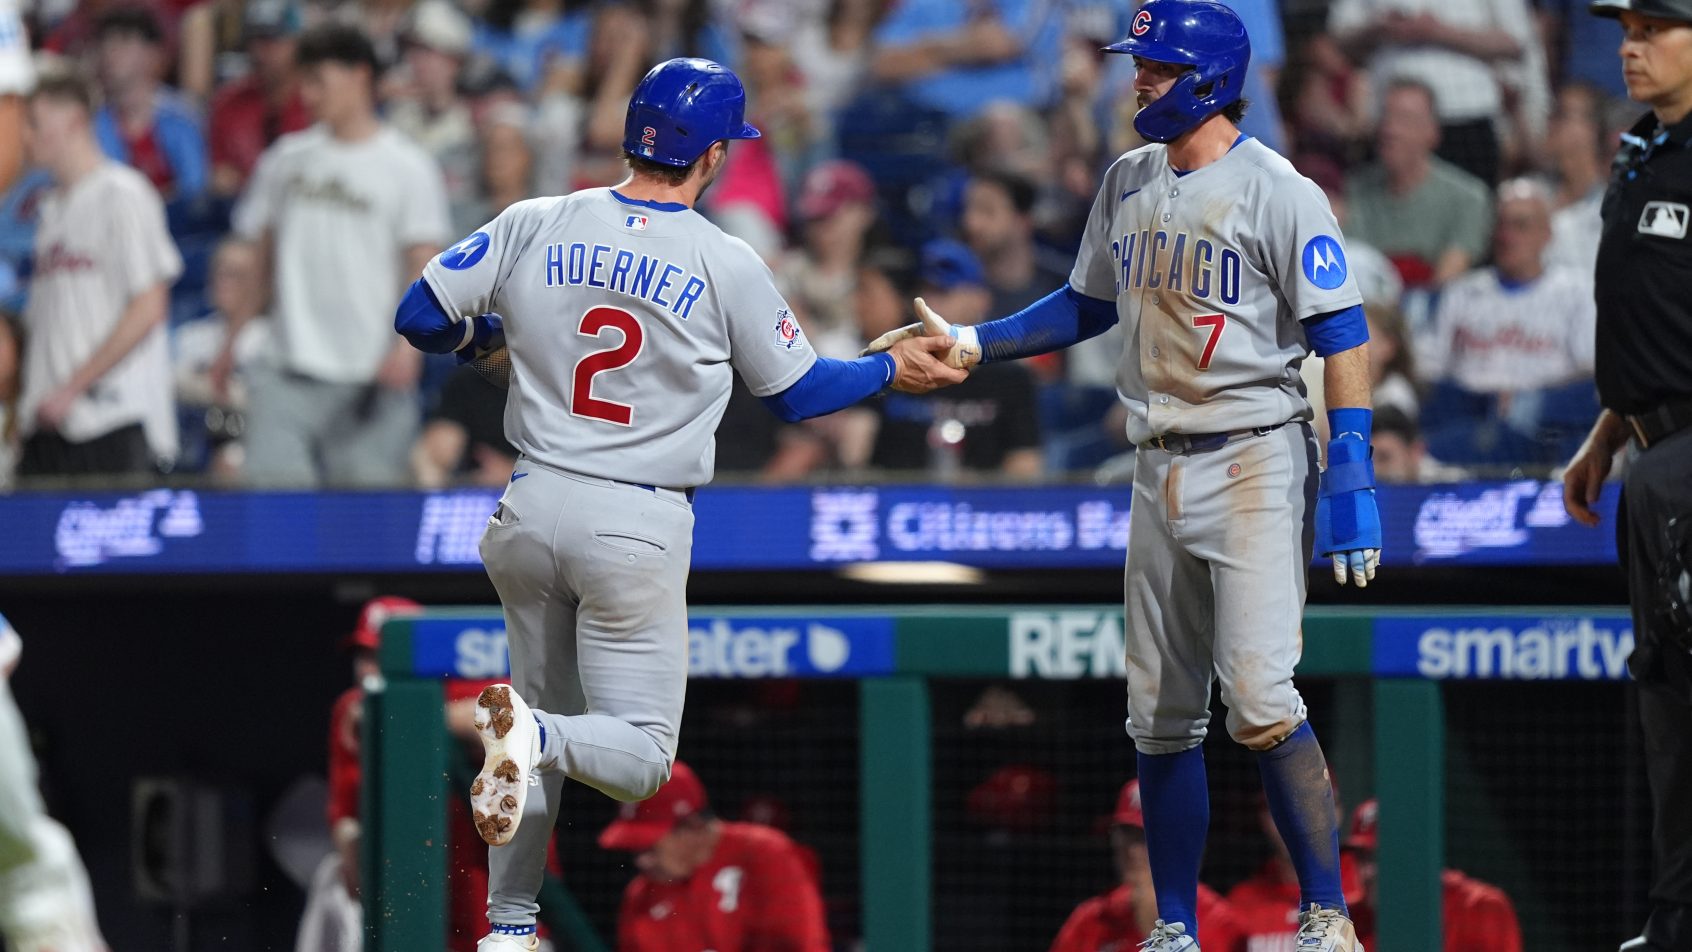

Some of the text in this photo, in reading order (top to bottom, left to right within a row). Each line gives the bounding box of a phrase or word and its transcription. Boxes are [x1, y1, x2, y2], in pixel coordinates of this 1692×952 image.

[1132, 10, 1152, 36] C
[641, 126, 656, 145] 2
[545, 241, 708, 321] HOERNER
[1112, 229, 1242, 306] CHICAGO
[570, 304, 645, 427] 2
[1191, 312, 1227, 370] 7
[888, 501, 1074, 551] Citizens
